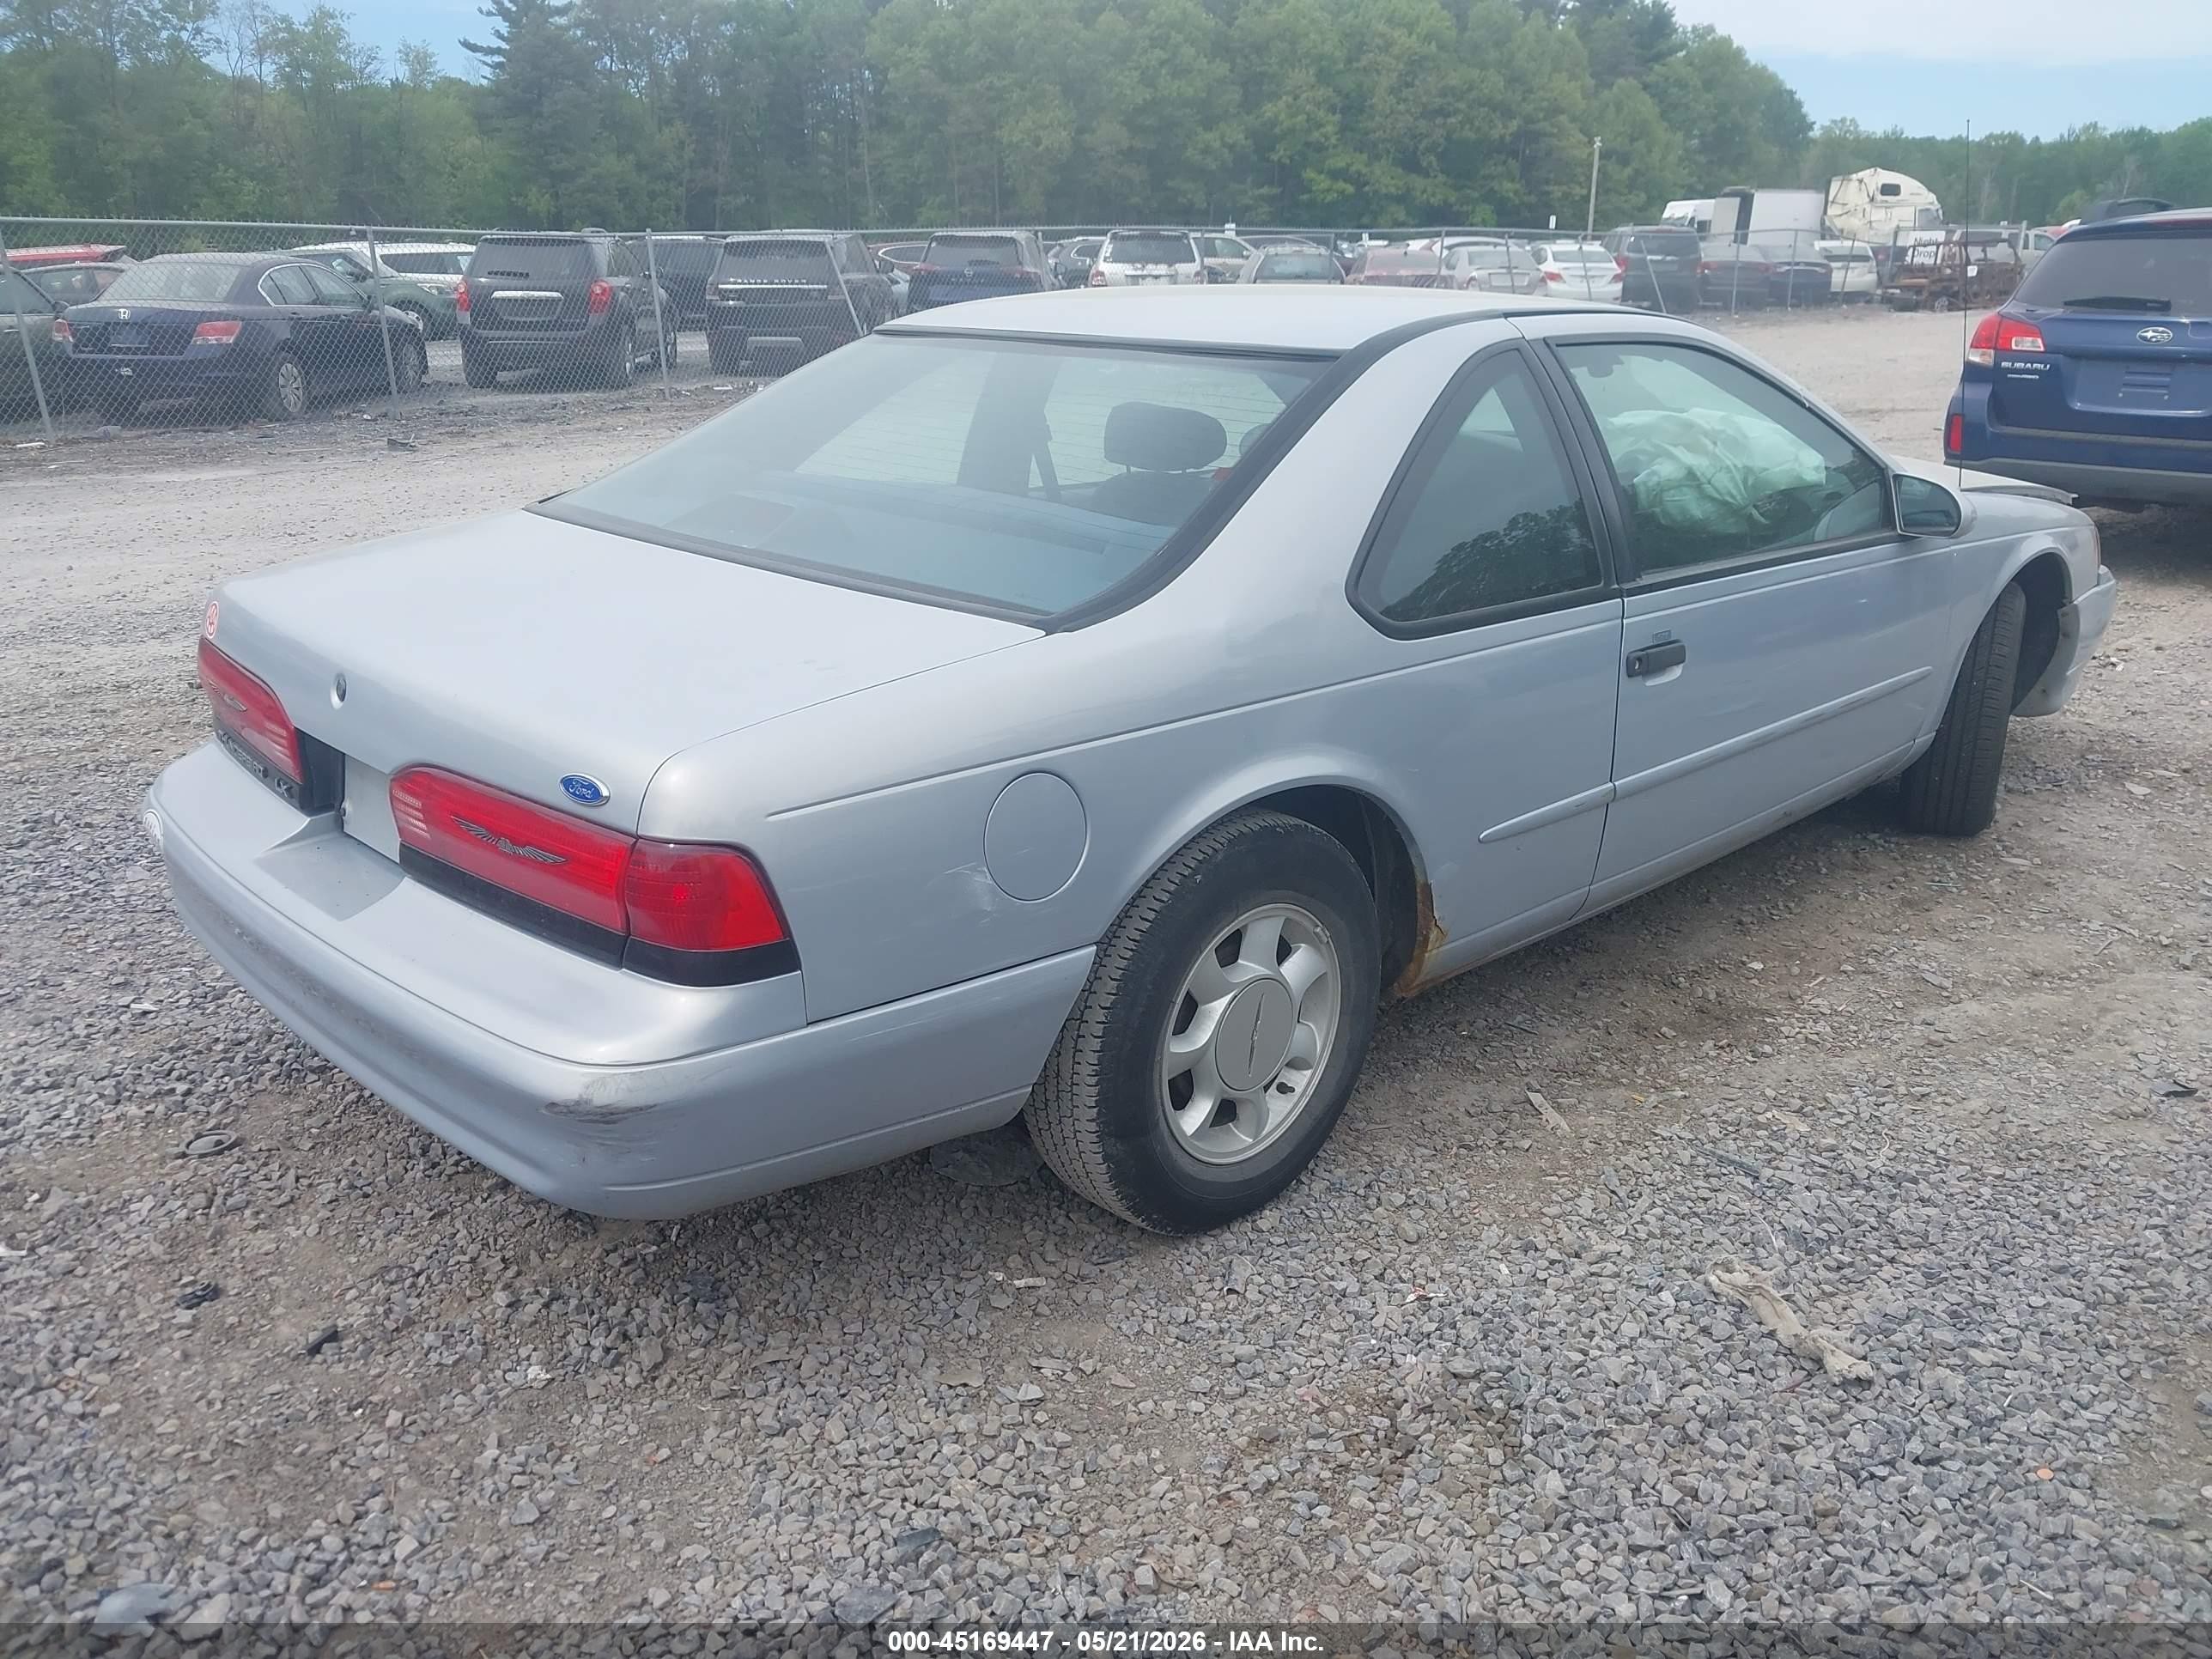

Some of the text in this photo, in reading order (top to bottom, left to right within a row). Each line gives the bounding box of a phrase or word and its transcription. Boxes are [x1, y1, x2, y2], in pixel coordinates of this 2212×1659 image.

[1914, 237, 1937, 247] Night
[1913, 248, 1936, 259] Drop
[2001, 362, 2051, 370] SUBARU
[275, 777, 292, 798] LX
